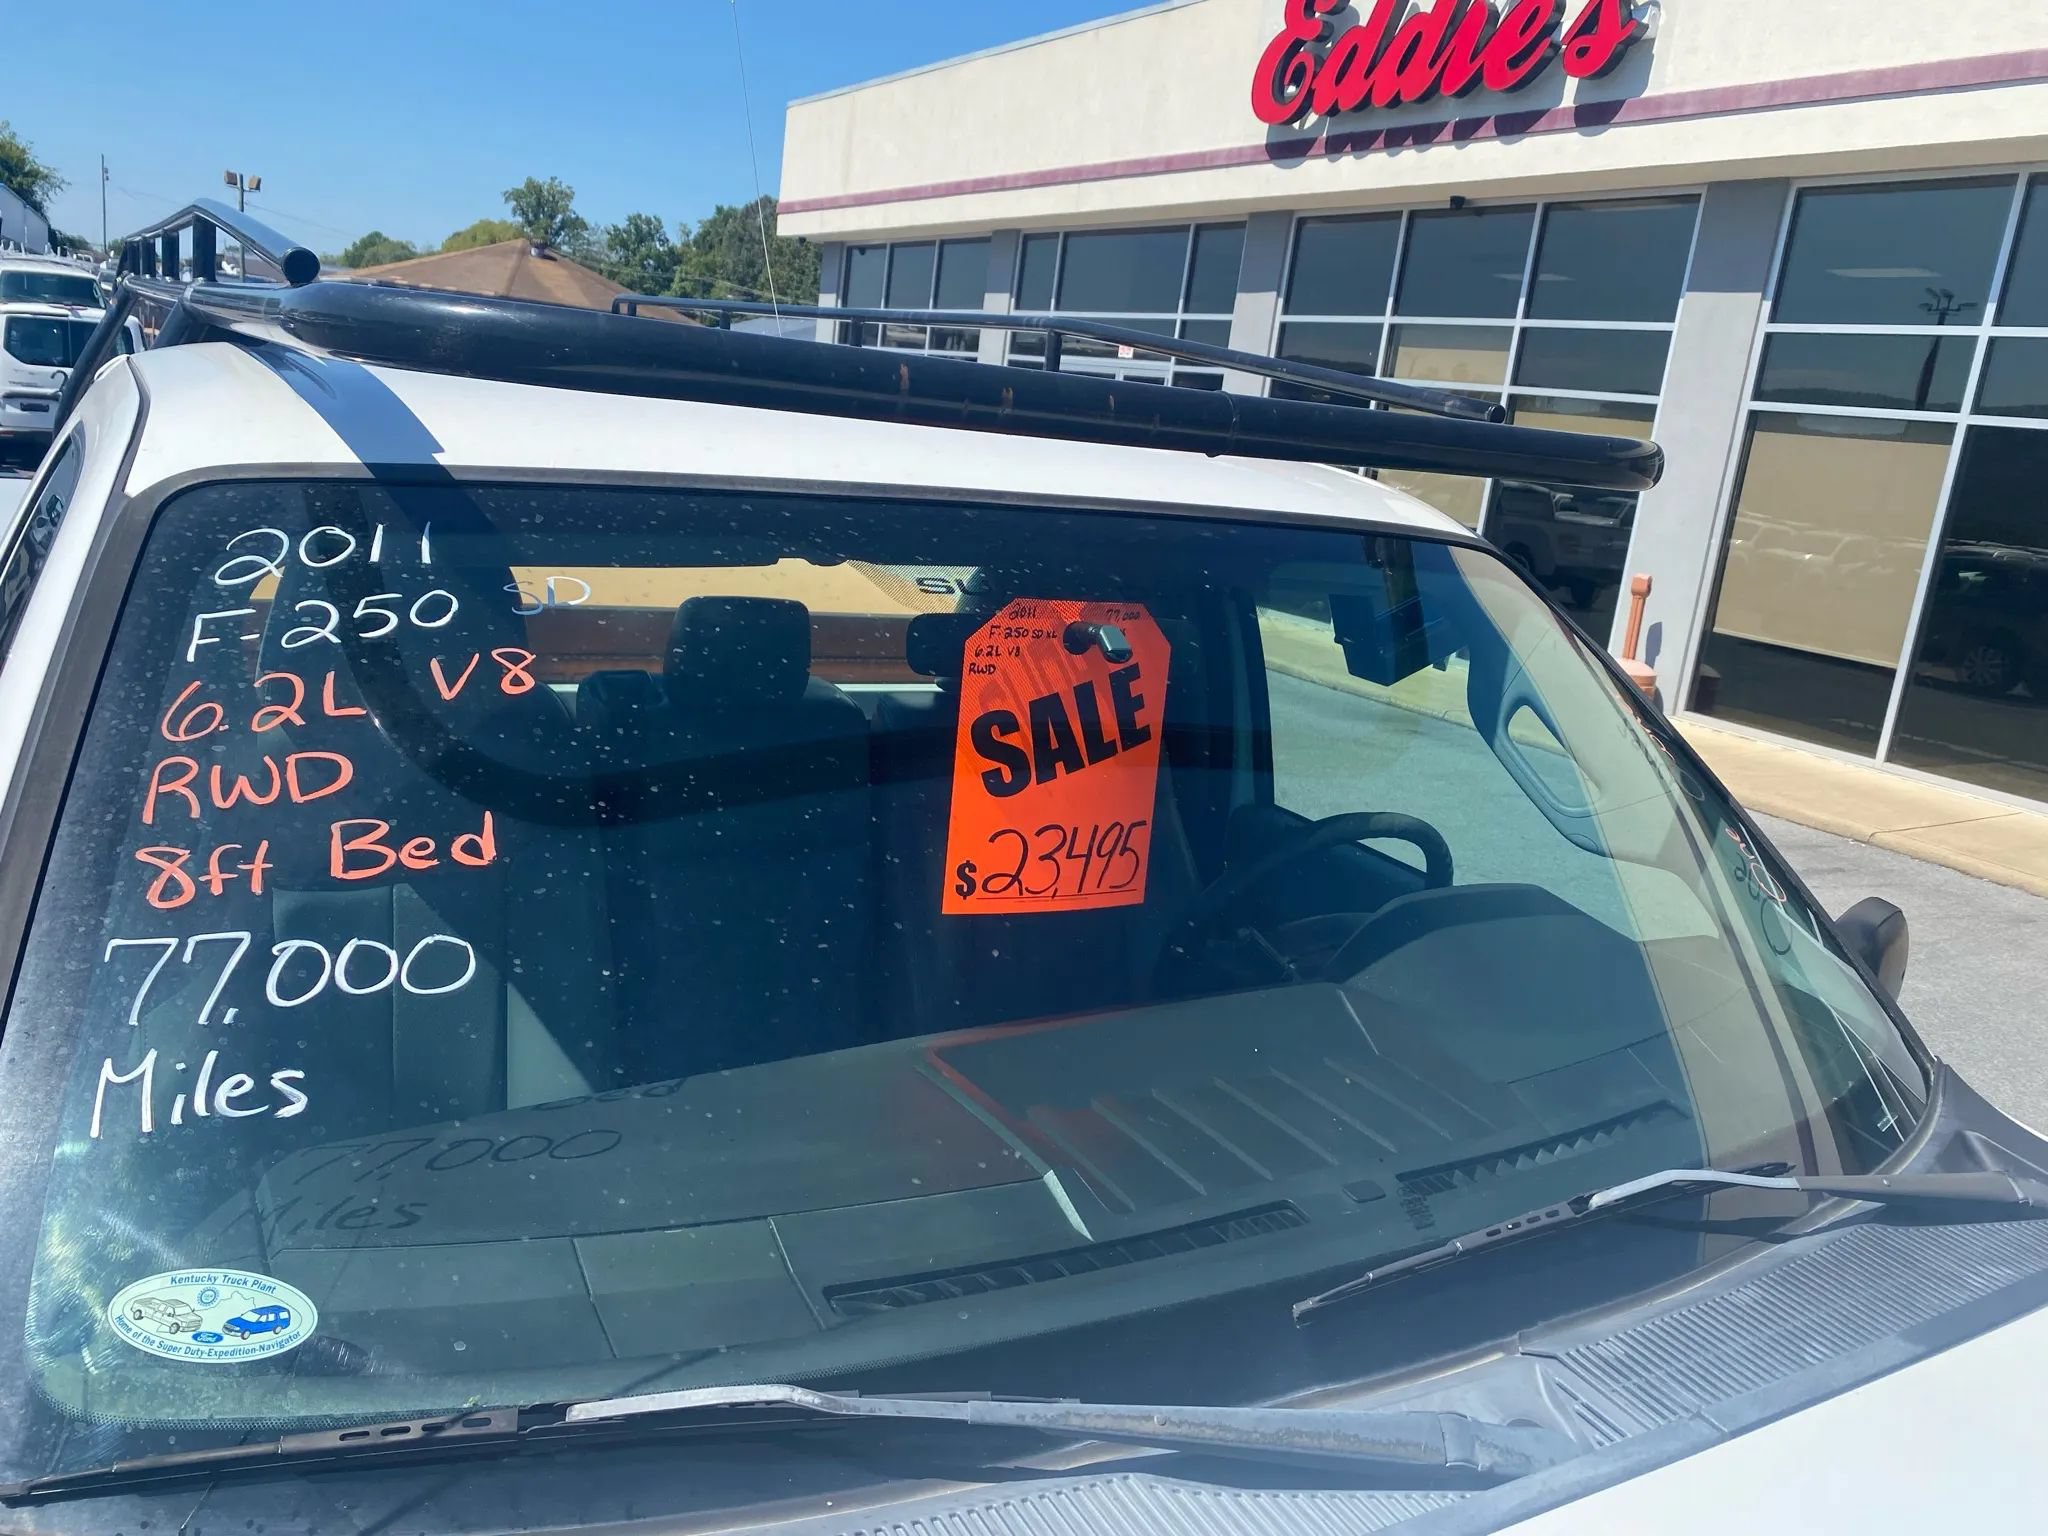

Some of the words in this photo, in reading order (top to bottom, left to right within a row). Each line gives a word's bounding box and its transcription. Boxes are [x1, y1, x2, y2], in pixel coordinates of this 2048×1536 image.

[1251, 0, 1638, 125] Eddies
[214, 521, 432, 587] 2011
[186, 588, 459, 663] F-250
[503, 575, 592, 616] SD
[1009, 603, 1037, 620] 2011
[969, 662, 997, 675] RWD
[1008, 645, 1020, 657] V8
[161, 670, 367, 743] 6.2L
[430, 647, 536, 701] V8
[971, 663, 1152, 798] SALE
[142, 751, 354, 825] RWD
[135, 839, 273, 909] 8ft
[330, 810, 498, 880] Bed
[89, 1047, 309, 1139] Miles
[171, 1274, 219, 1285] Kentucky
[222, 1275, 249, 1287] Truck
[251, 1279, 277, 1294] Plant
[115, 1314, 133, 1334] Home
[142, 1333, 156, 1346] the
[157, 1340, 183, 1353] Super
